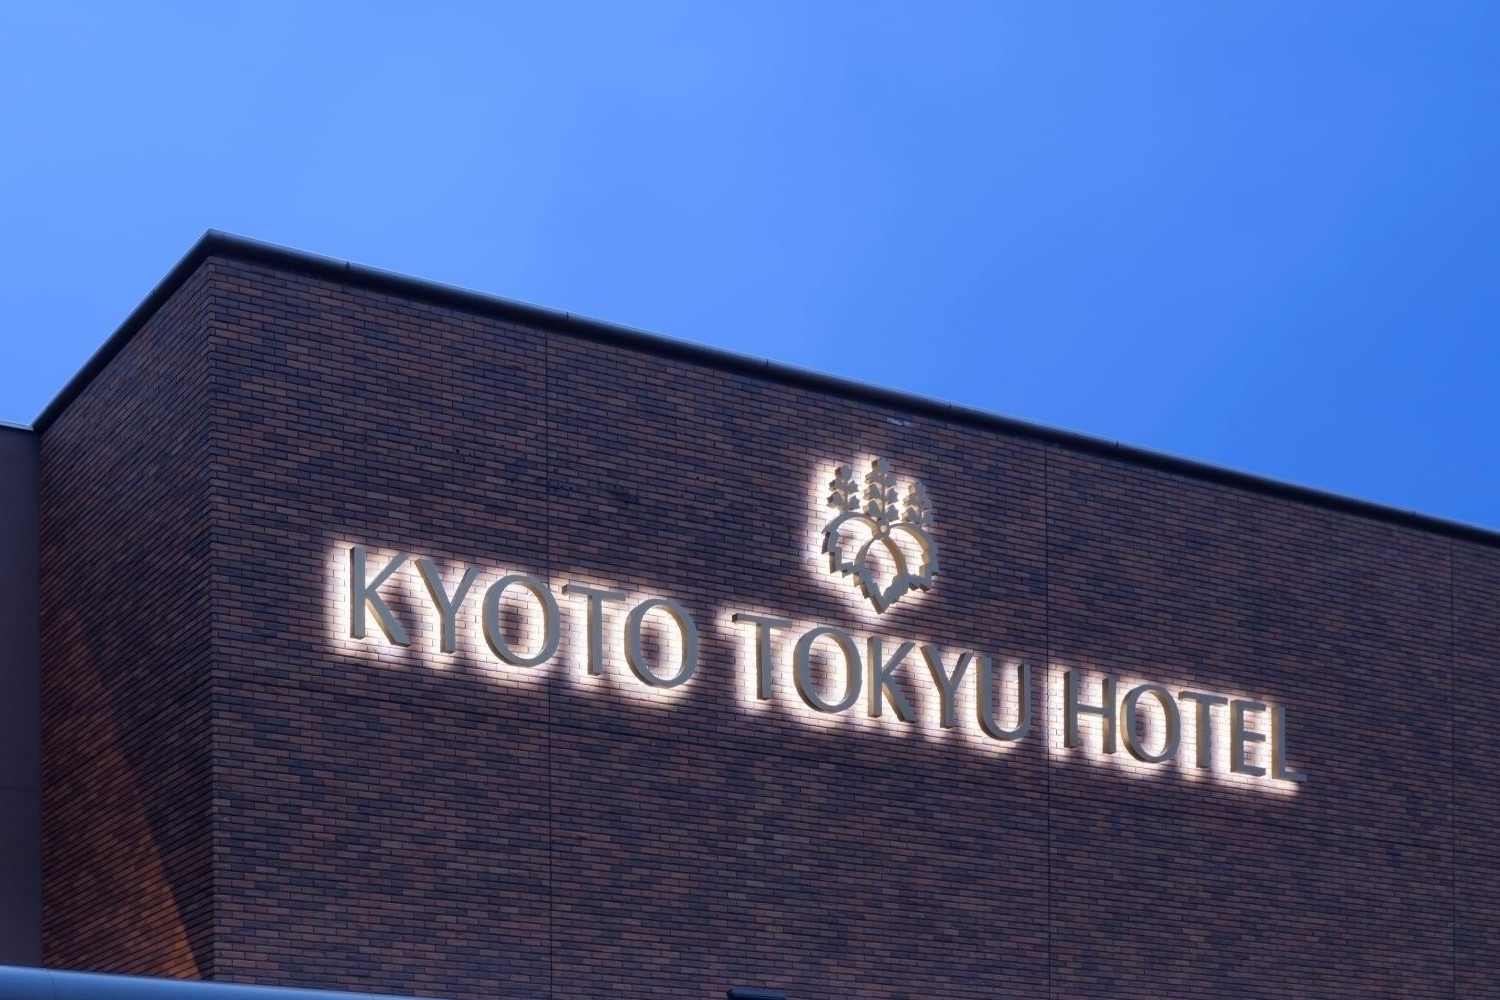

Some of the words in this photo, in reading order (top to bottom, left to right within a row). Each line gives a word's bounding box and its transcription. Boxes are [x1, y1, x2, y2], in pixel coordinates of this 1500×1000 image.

[349, 546, 698, 689] KYOTO
[731, 612, 1031, 742] TOKYU
[1063, 670, 1308, 783] HOTEL
